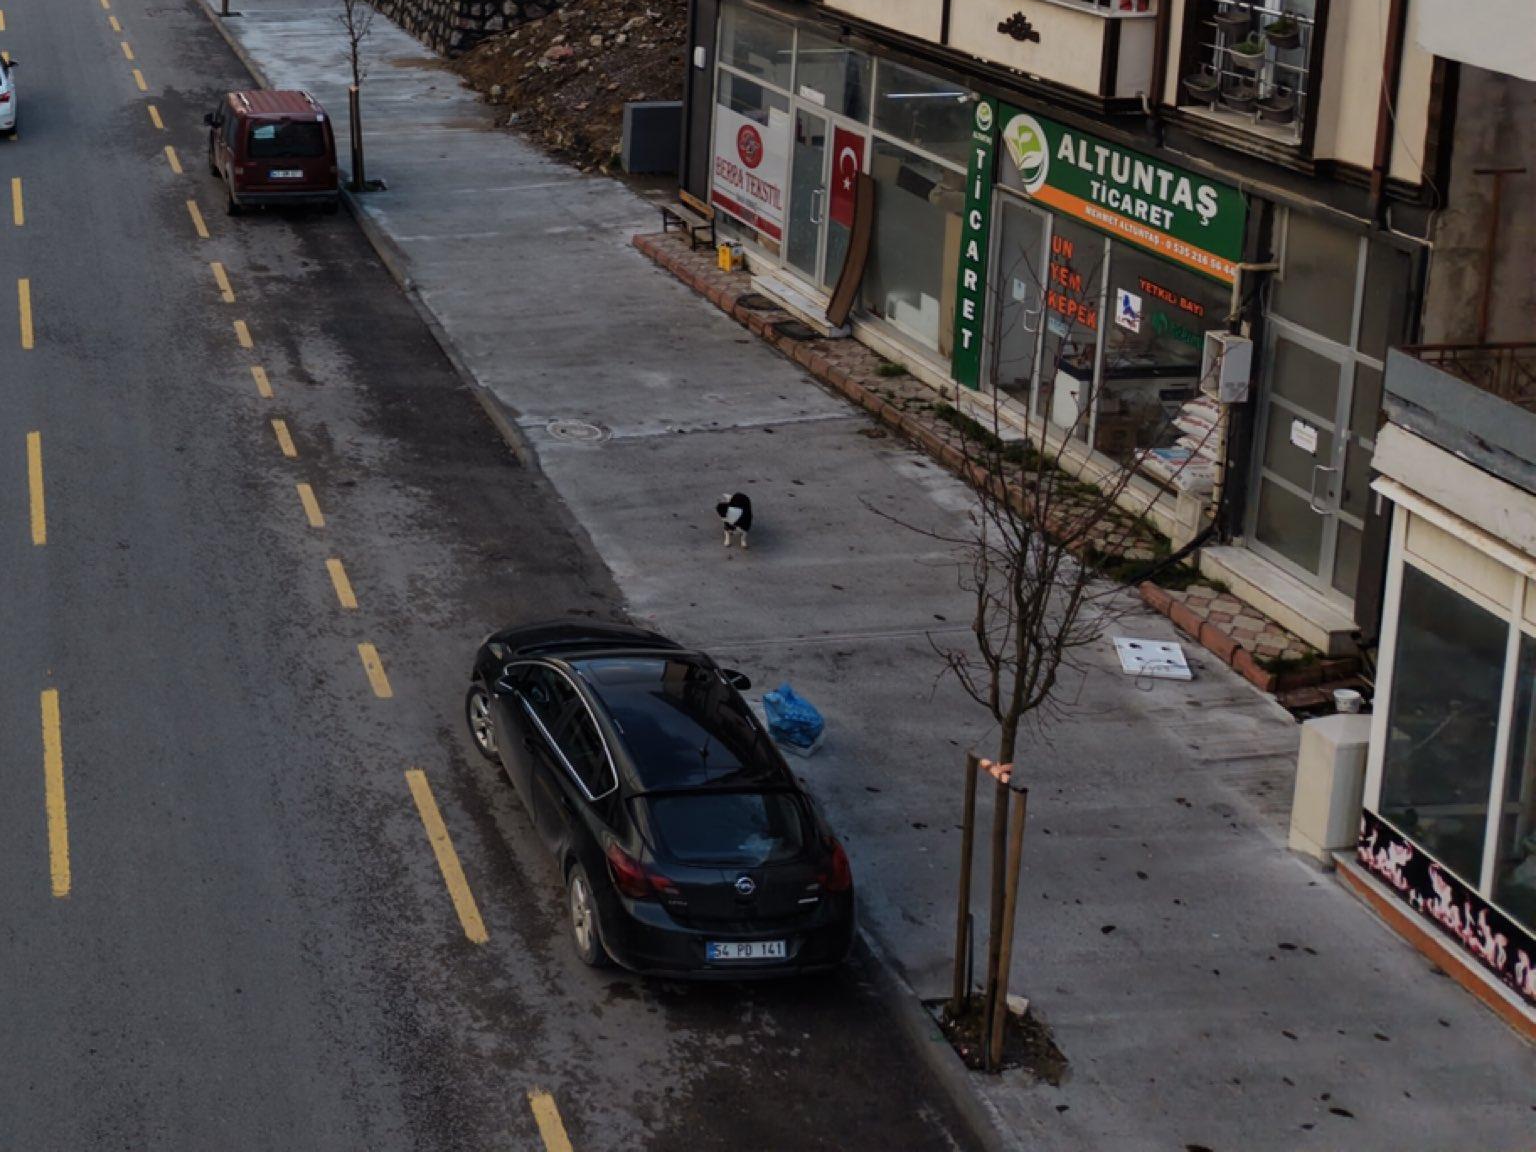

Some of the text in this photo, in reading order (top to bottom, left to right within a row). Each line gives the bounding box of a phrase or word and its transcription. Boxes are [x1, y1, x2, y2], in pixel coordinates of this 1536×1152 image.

[1057, 133, 1218, 226] ALTUNTAŞ
[1090, 179, 1175, 230] TİCARET
[961, 149, 986, 349] TİCARET
[1052, 235, 1073, 258] UN
[1119, 220, 1160, 246] ALTUNTAŞ
[1050, 261, 1082, 294] YEM
[1048, 289, 1098, 331] KEPEK
[761, 942, 782, 956] 141
